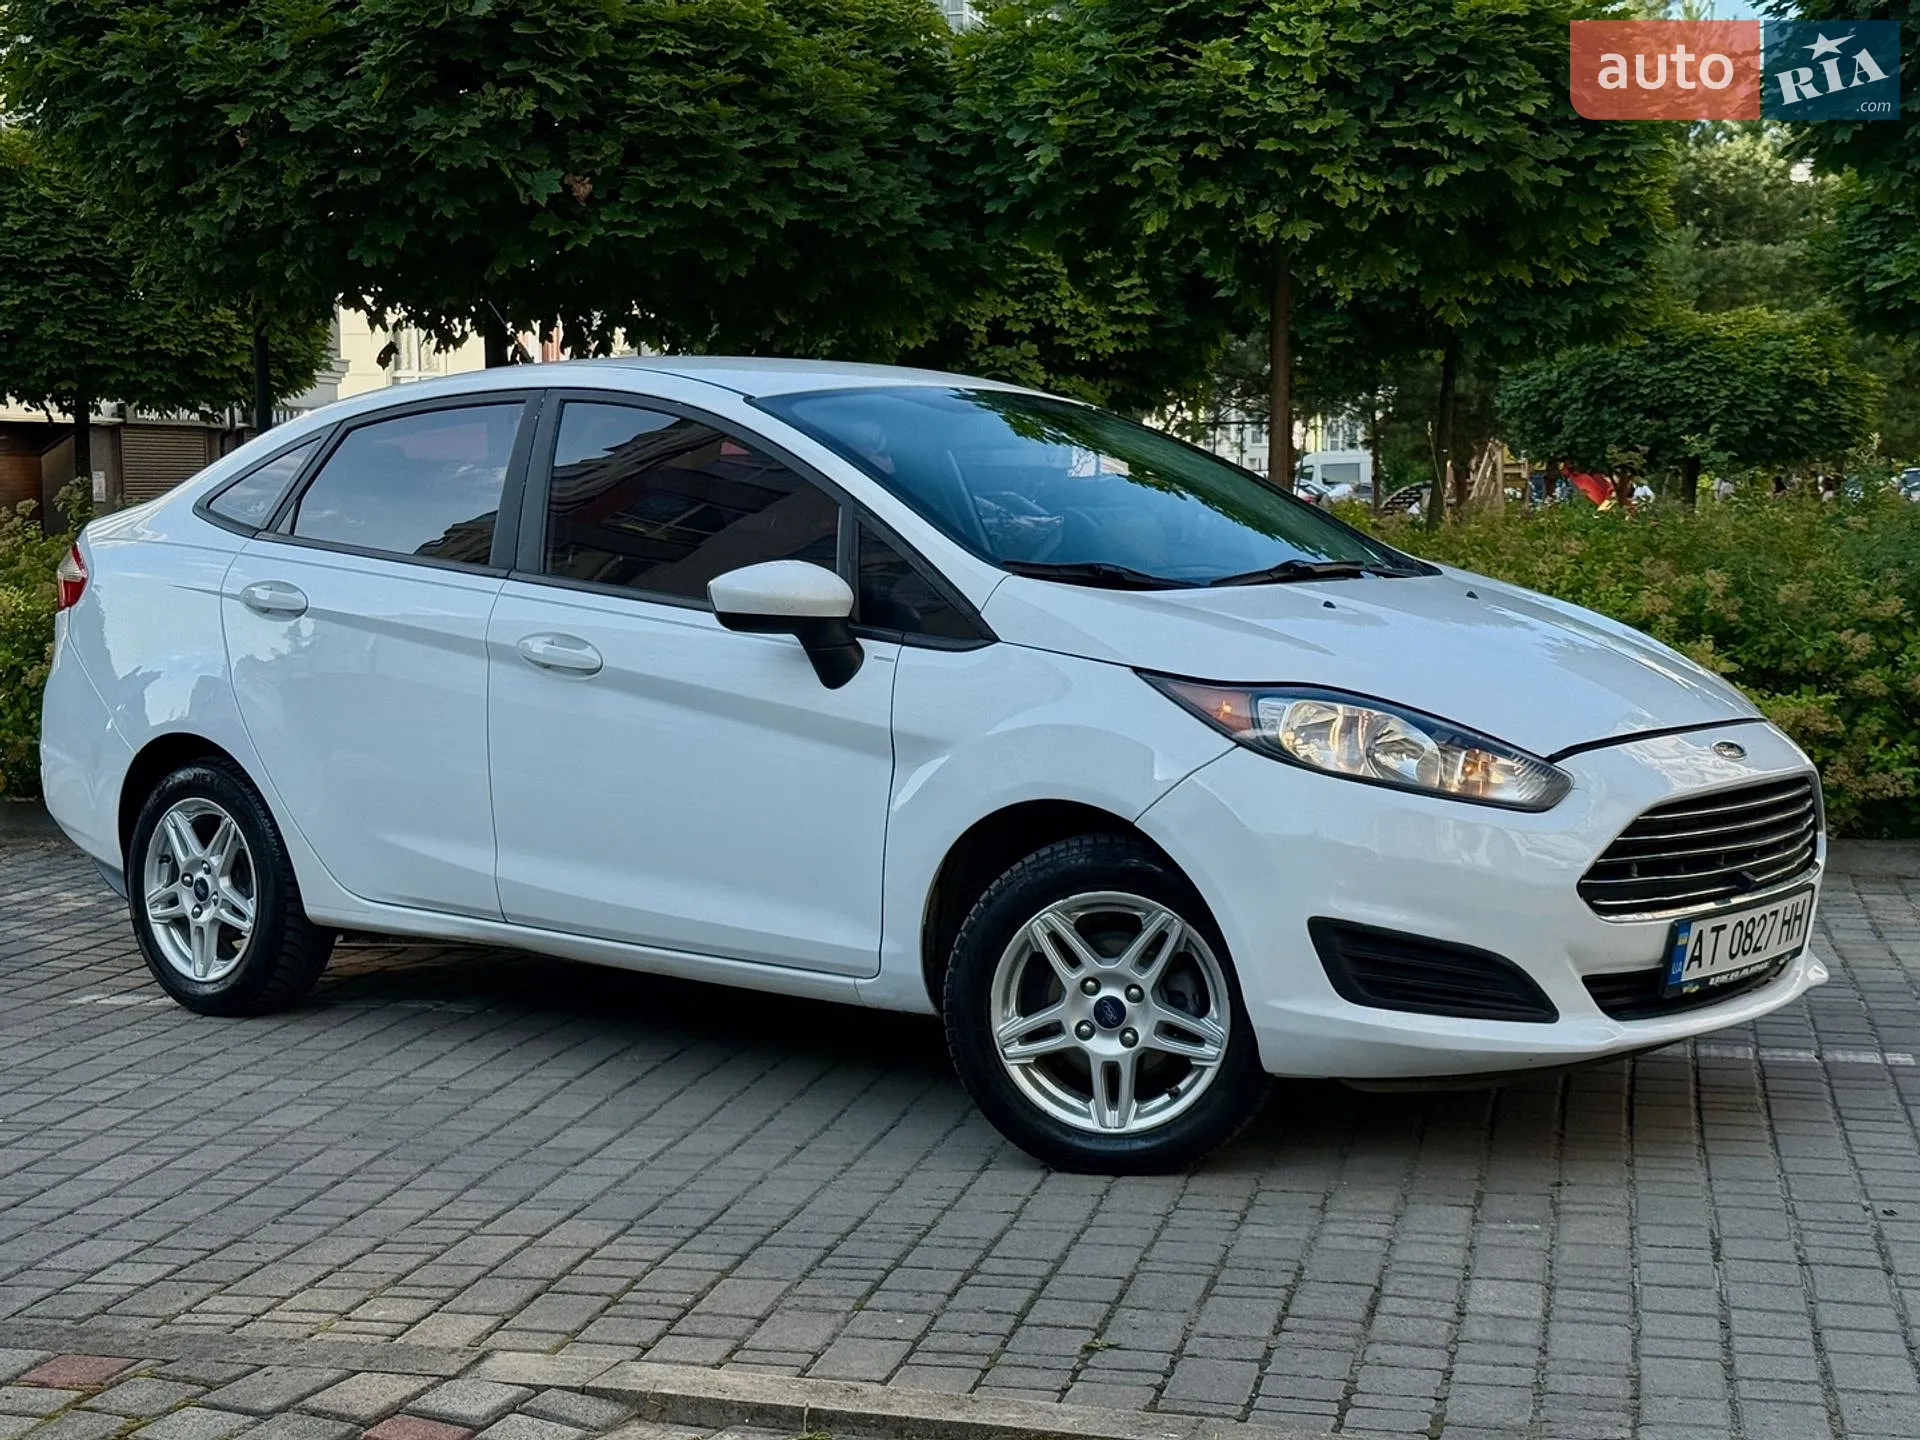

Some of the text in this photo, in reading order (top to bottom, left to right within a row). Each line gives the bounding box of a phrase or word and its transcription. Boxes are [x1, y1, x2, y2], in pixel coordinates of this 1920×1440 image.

[1685, 898, 1807, 972] AT 0827 HH
